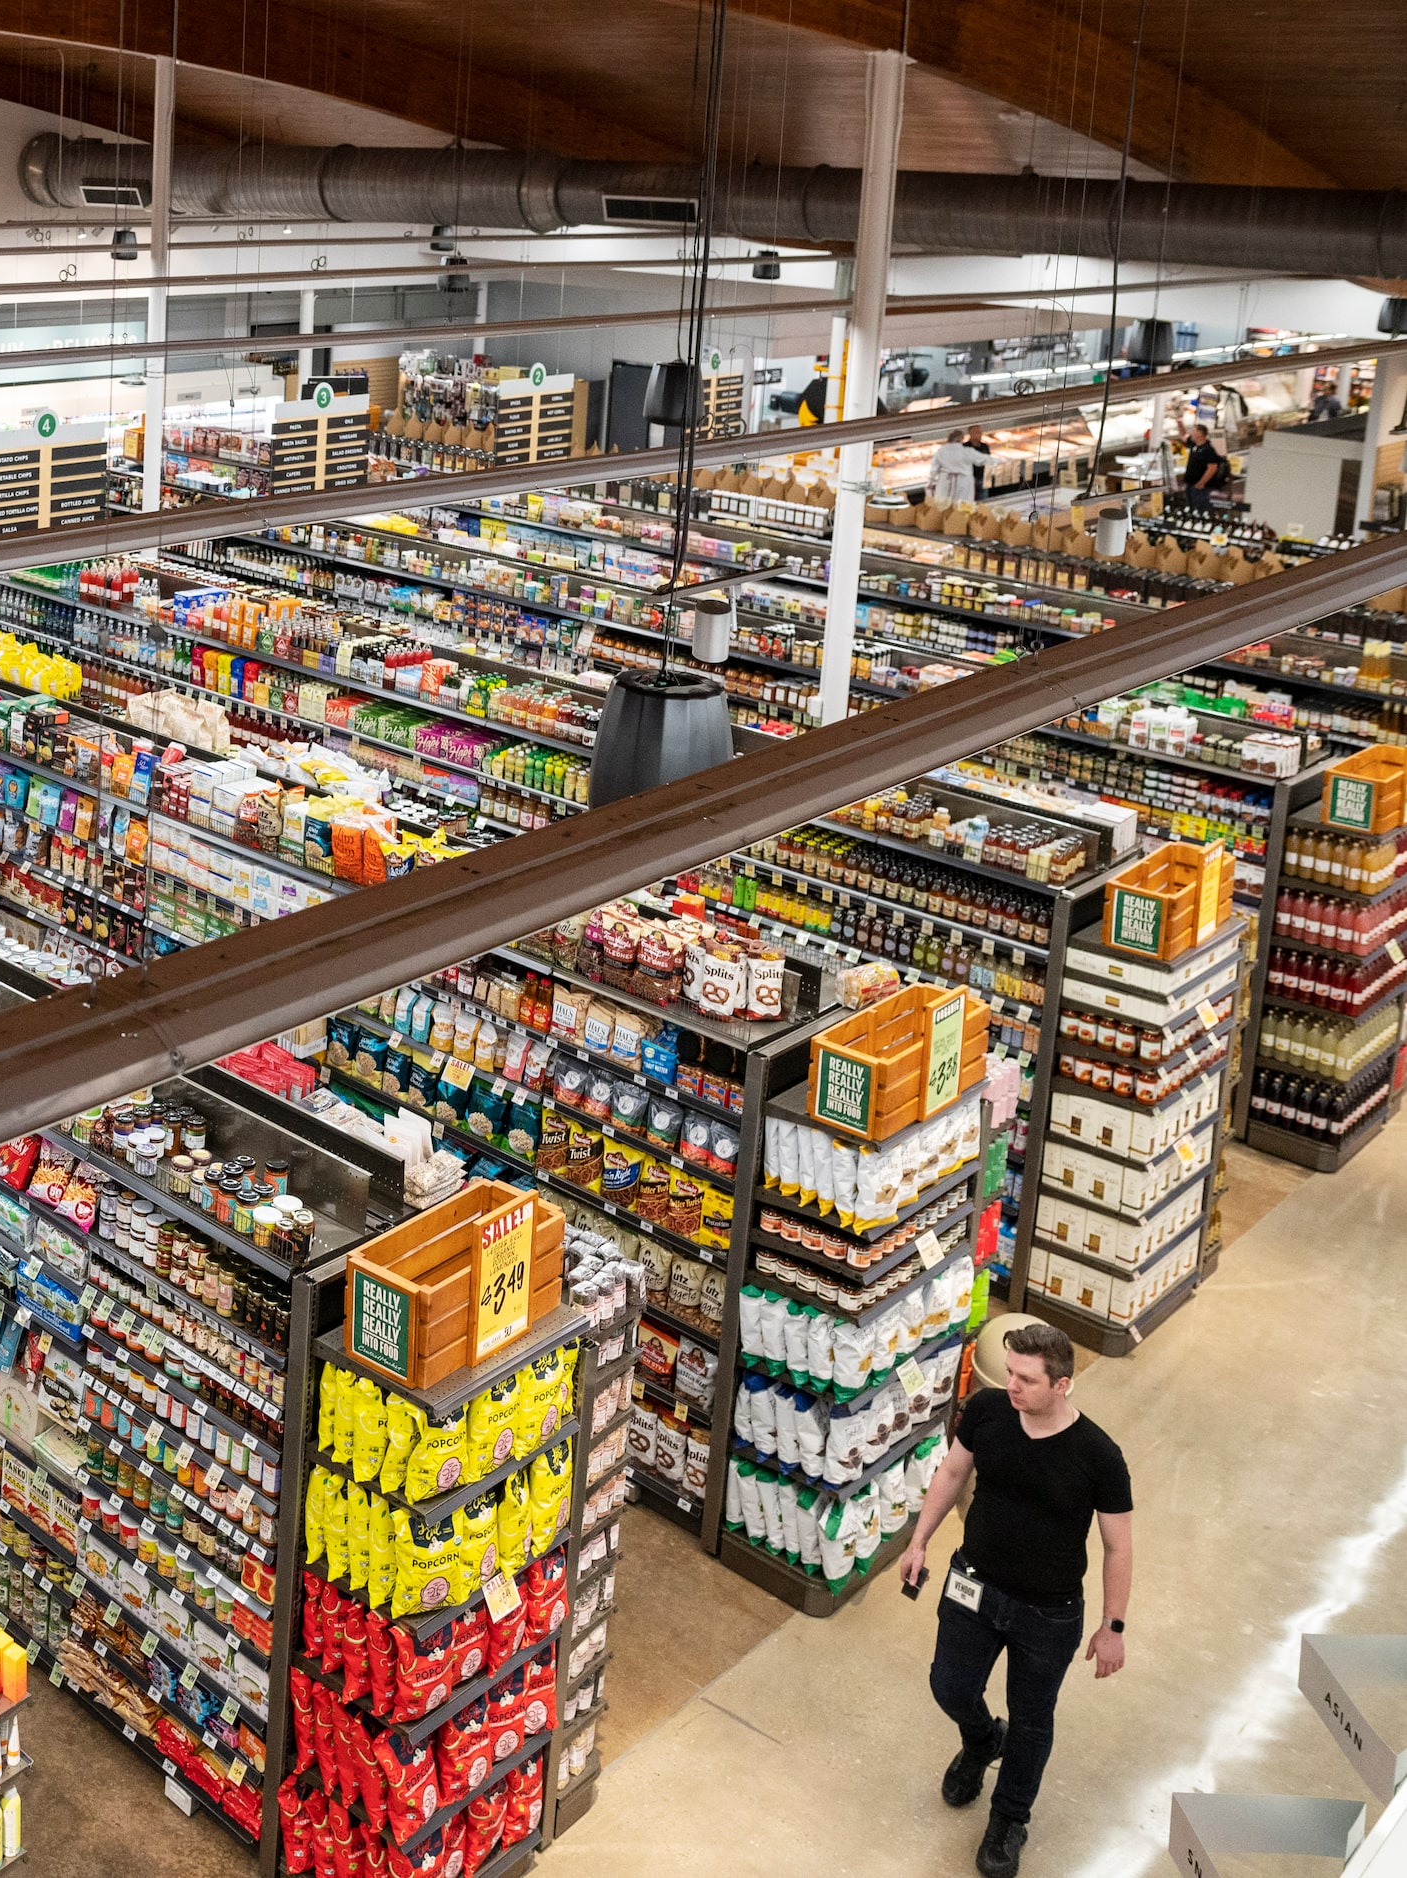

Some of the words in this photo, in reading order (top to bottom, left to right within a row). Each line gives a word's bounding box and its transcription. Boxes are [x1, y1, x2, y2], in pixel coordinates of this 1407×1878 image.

[535, 371, 540, 382] 2
[320, 392, 327, 404] 3
[42, 419, 51, 432] 4
[14, 454, 29, 462] CHIPS
[18, 471, 32, 480] CHIPS
[15, 489, 30, 497] CHIPS
[60, 500, 82, 508] BOTTLED
[82, 498, 96, 506] JUICE
[6, 507, 25, 516] TORTILLA
[60, 517, 80, 525] CANNED
[82, 515, 95, 523] JUICE
[2, 526, 18, 534] SALSA
[703, 964, 735, 981] Splits
[754, 968, 783, 980] Splits
[555, 1003, 573, 1018] HAL'S
[588, 1020, 607, 1035] HAL'S
[615, 1026, 635, 1042] HAL'S
[449, 1058, 471, 1071] SALE!
[829, 1056, 865, 1081] REALLY,
[829, 1070, 864, 1093] REALLY,
[828, 1083, 863, 1106] REALLY
[826, 1098, 842, 1112] INTO
[842, 1105, 862, 1120] FOOD
[541, 1132, 566, 1145] Twist
[570, 1147, 591, 1160] Twist
[482, 1206, 524, 1250] SALE!
[642, 1256, 656, 1270] utz
[673, 1270, 689, 1285] utz
[363, 1279, 401, 1314] REALLY,
[705, 1285, 719, 1299] utz
[362, 1296, 401, 1331] REALLY,
[42, 1311, 71, 1335] Seaweed
[362, 1313, 399, 1344] REALLY
[361, 1330, 379, 1350] INTO
[380, 1340, 399, 1360] FOOD
[5, 1458, 27, 1479] PANKO
[56, 1494, 78, 1517] PANKO
[412, 1552, 460, 1570] POPCORN
[955, 1581, 975, 1598] VENDOR
[1324, 1692, 1363, 1752] ASIAN
